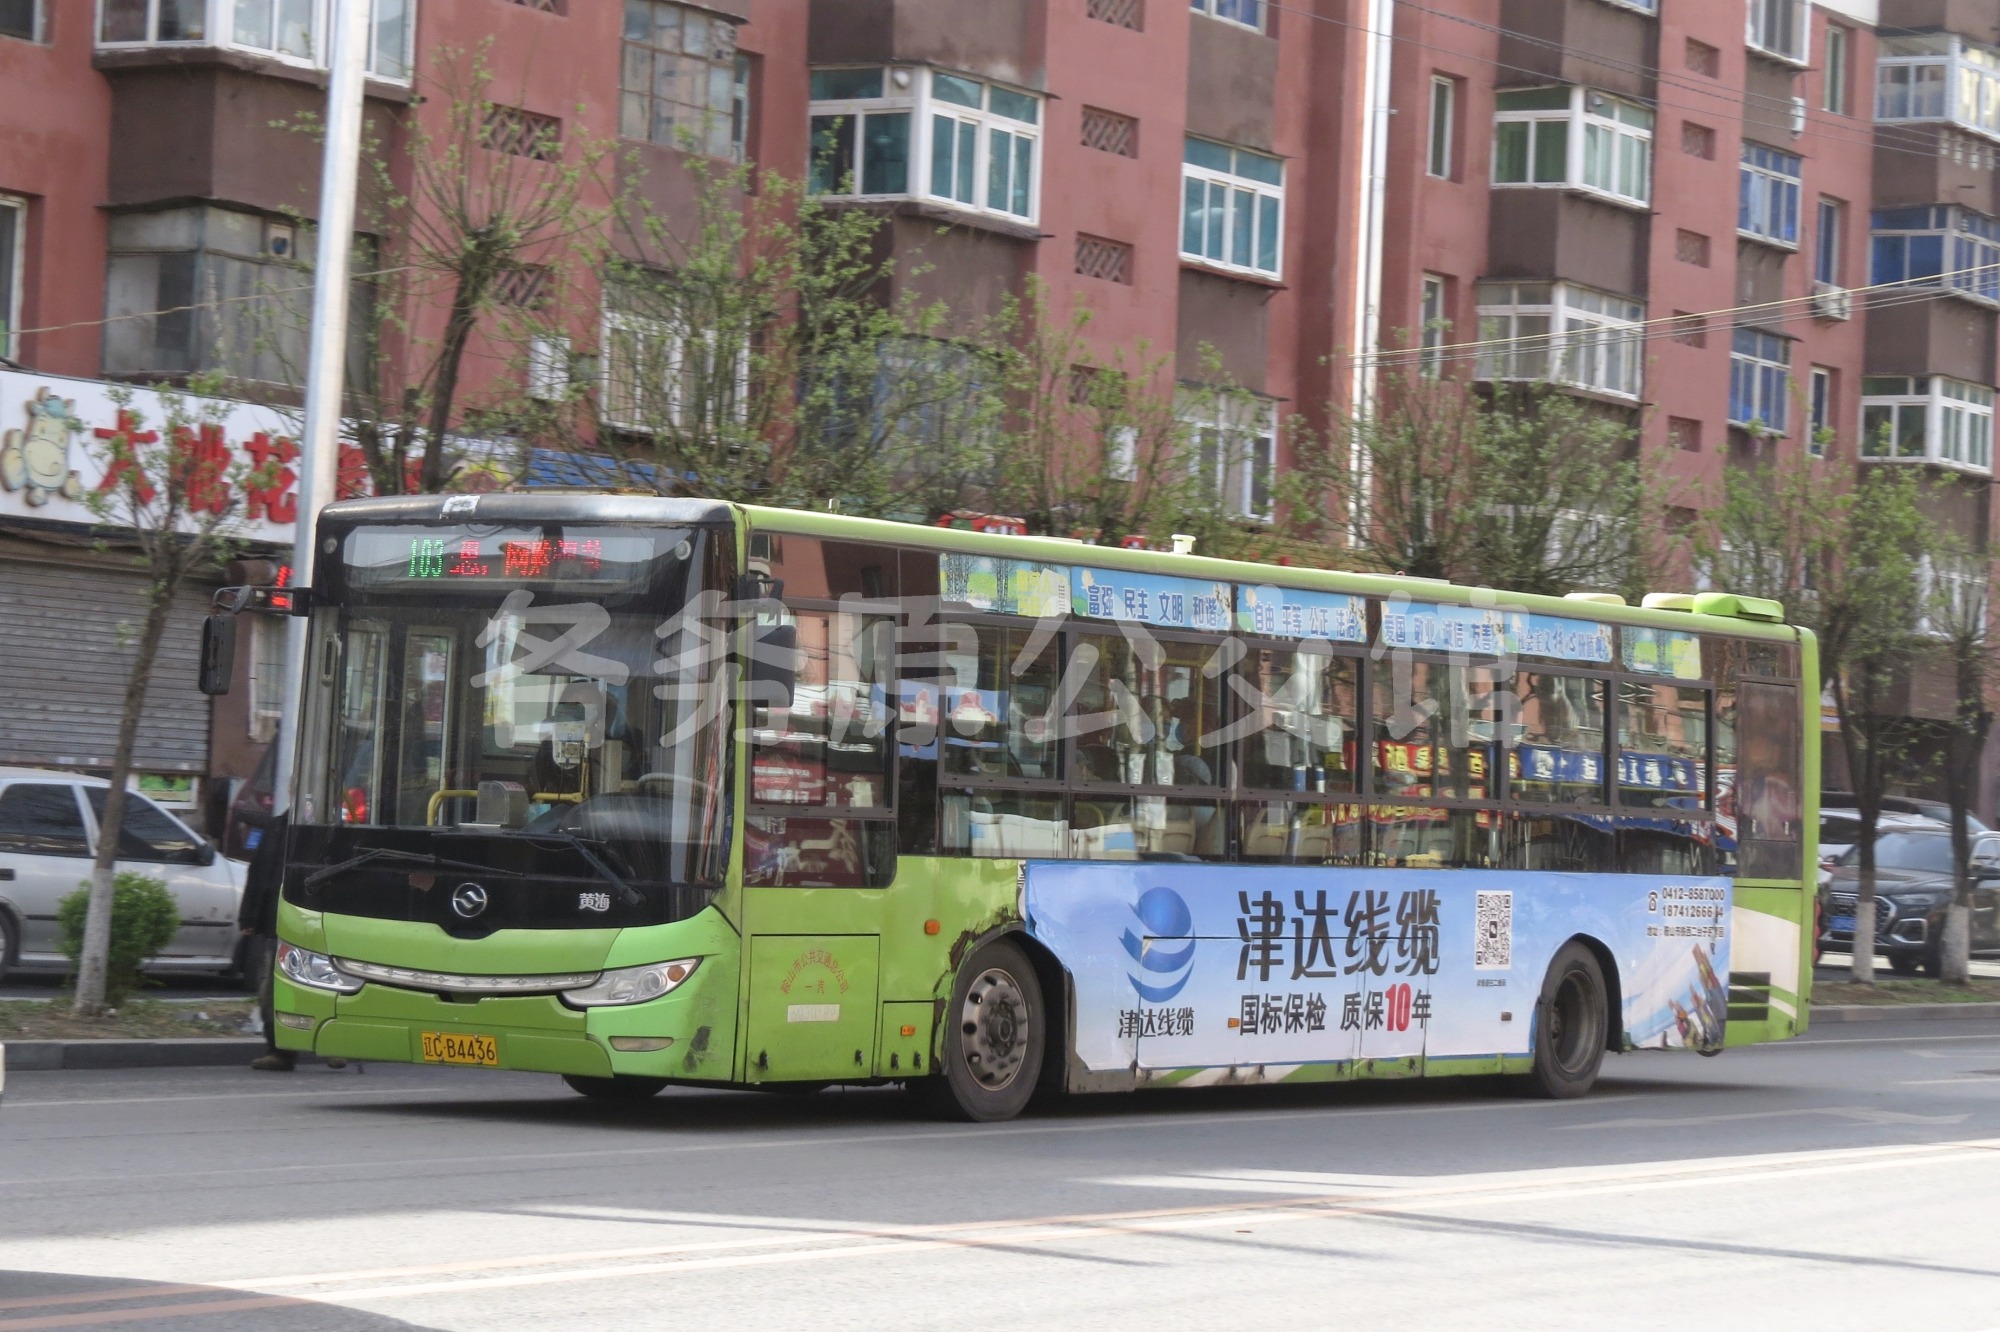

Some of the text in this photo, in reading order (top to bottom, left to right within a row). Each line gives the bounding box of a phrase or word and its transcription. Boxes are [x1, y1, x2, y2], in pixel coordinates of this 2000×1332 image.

[409, 537, 444, 577] 103
[1088, 585, 1113, 618] 富强
[1124, 587, 1148, 620] 民主
[1159, 591, 1183, 623] 文明
[1193, 595, 1218, 628] 和谐
[1255, 602, 1356, 639] 自由 平等 公正 法治
[1385, 614, 1492, 651] 爱国 敬业 诚信 友善
[579, 892, 610, 911] 黄海
[1236, 888, 1442, 982] 津达线缆
[1117, 1007, 1195, 1039] 津达线缆
[1239, 982, 1432, 1036] 国标保检 质保10年
